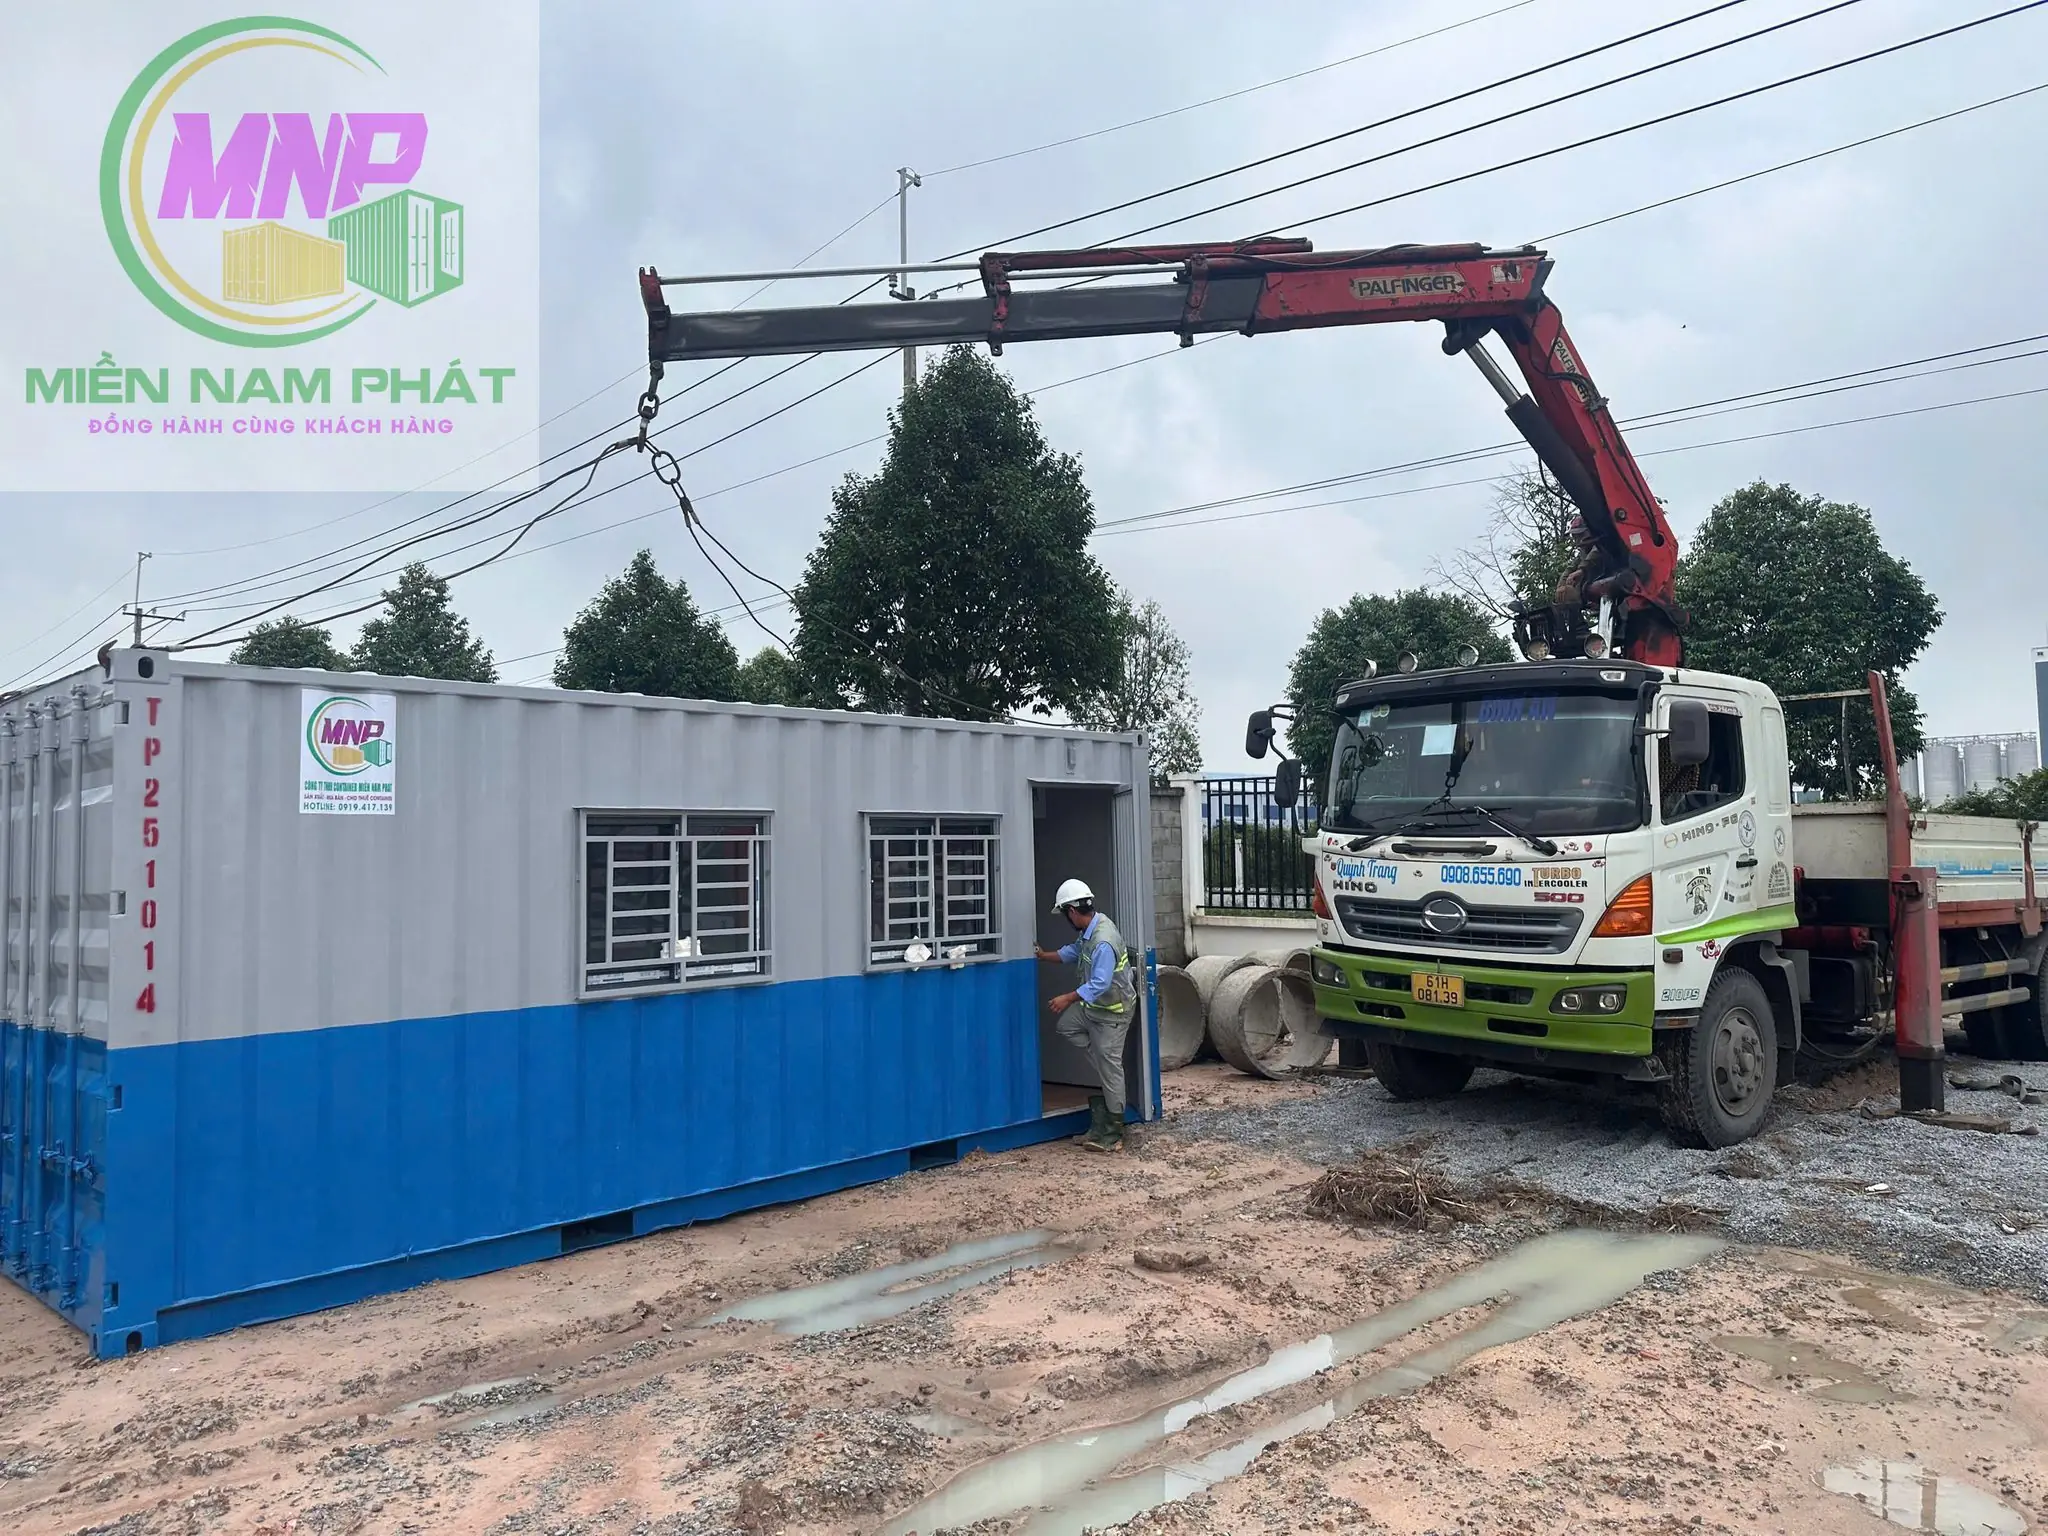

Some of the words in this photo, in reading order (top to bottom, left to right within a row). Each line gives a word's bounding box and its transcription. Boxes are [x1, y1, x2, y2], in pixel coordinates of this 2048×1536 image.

[1358, 275, 1457, 296] PALFINGER
[320, 717, 385, 745] MNP
[304, 802, 336, 810] HOTLINE:
[136, 697, 162, 1013] TP251014
[1367, 860, 1398, 884] Trang
[1441, 864, 1522, 886] 0908.655.690
[1532, 867, 1582, 887] TURBO
[1333, 880, 1378, 893] HINO
[1534, 892, 1584, 903] 500
[1426, 975, 1448, 990] 61H
[1418, 988, 1458, 1004] 081.39
[1661, 988, 1700, 1002] 210PS
